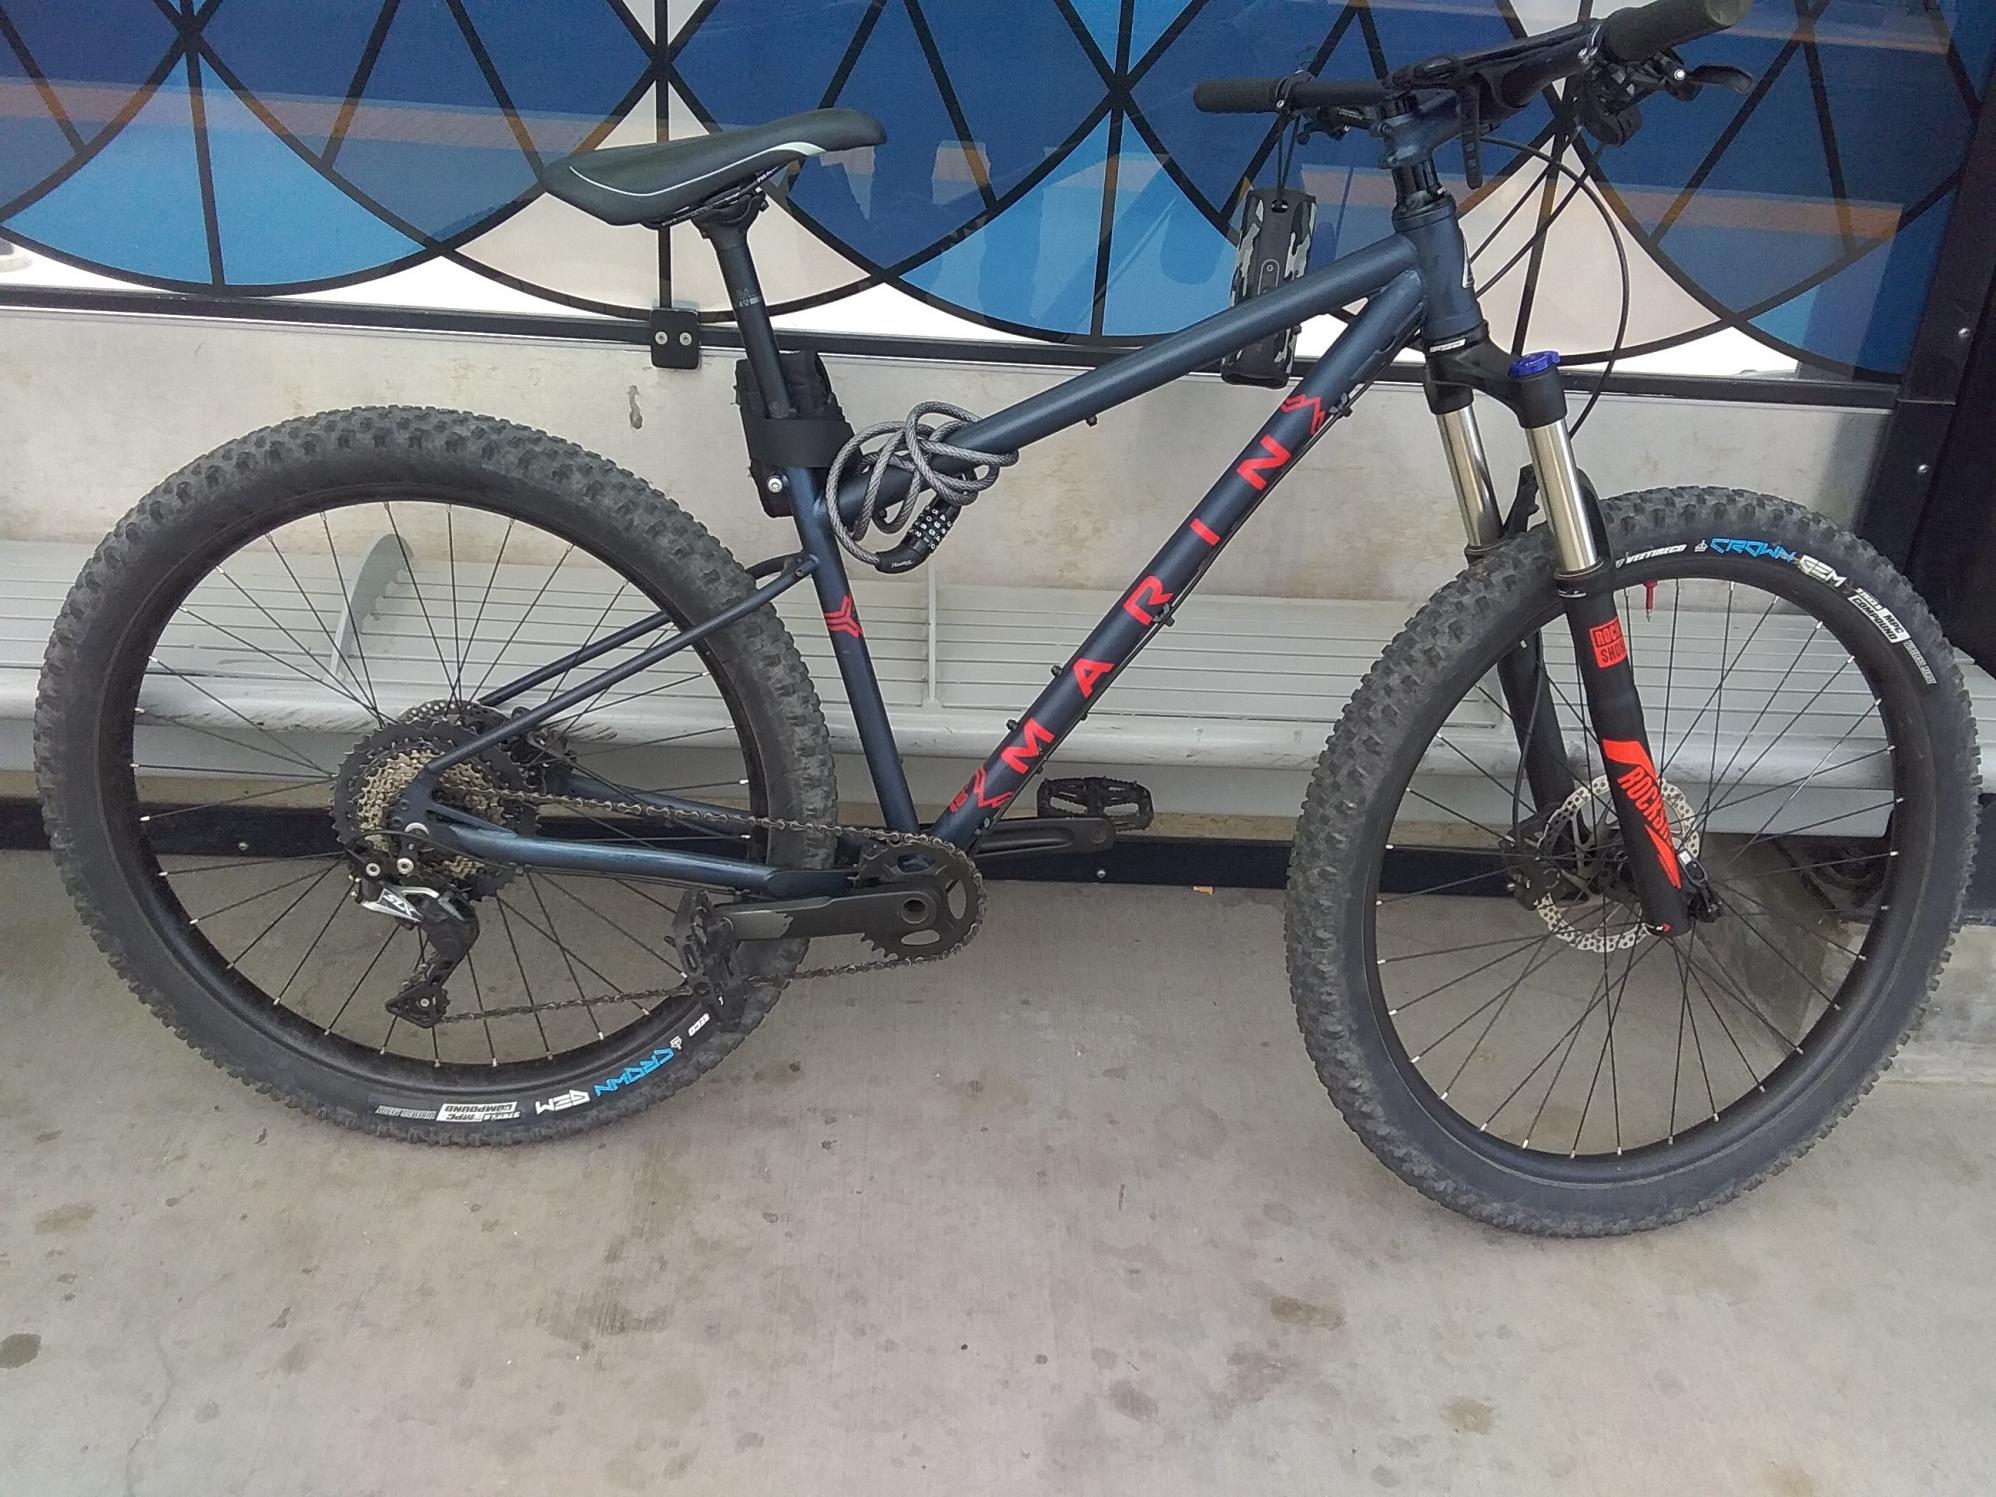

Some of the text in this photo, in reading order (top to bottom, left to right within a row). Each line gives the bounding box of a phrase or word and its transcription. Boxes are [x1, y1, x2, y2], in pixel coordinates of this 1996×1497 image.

[1710, 536, 1797, 563] CROWN
[1799, 554, 1848, 588] GEM
[1000, 434, 1292, 775] MARIN
[1850, 596, 1899, 641] COMPOUND
[1884, 613, 1905, 635] MPC
[383, 894, 415, 918] SLX
[594, 1047, 674, 1097] CROWN
[534, 1089, 591, 1115] GEM
